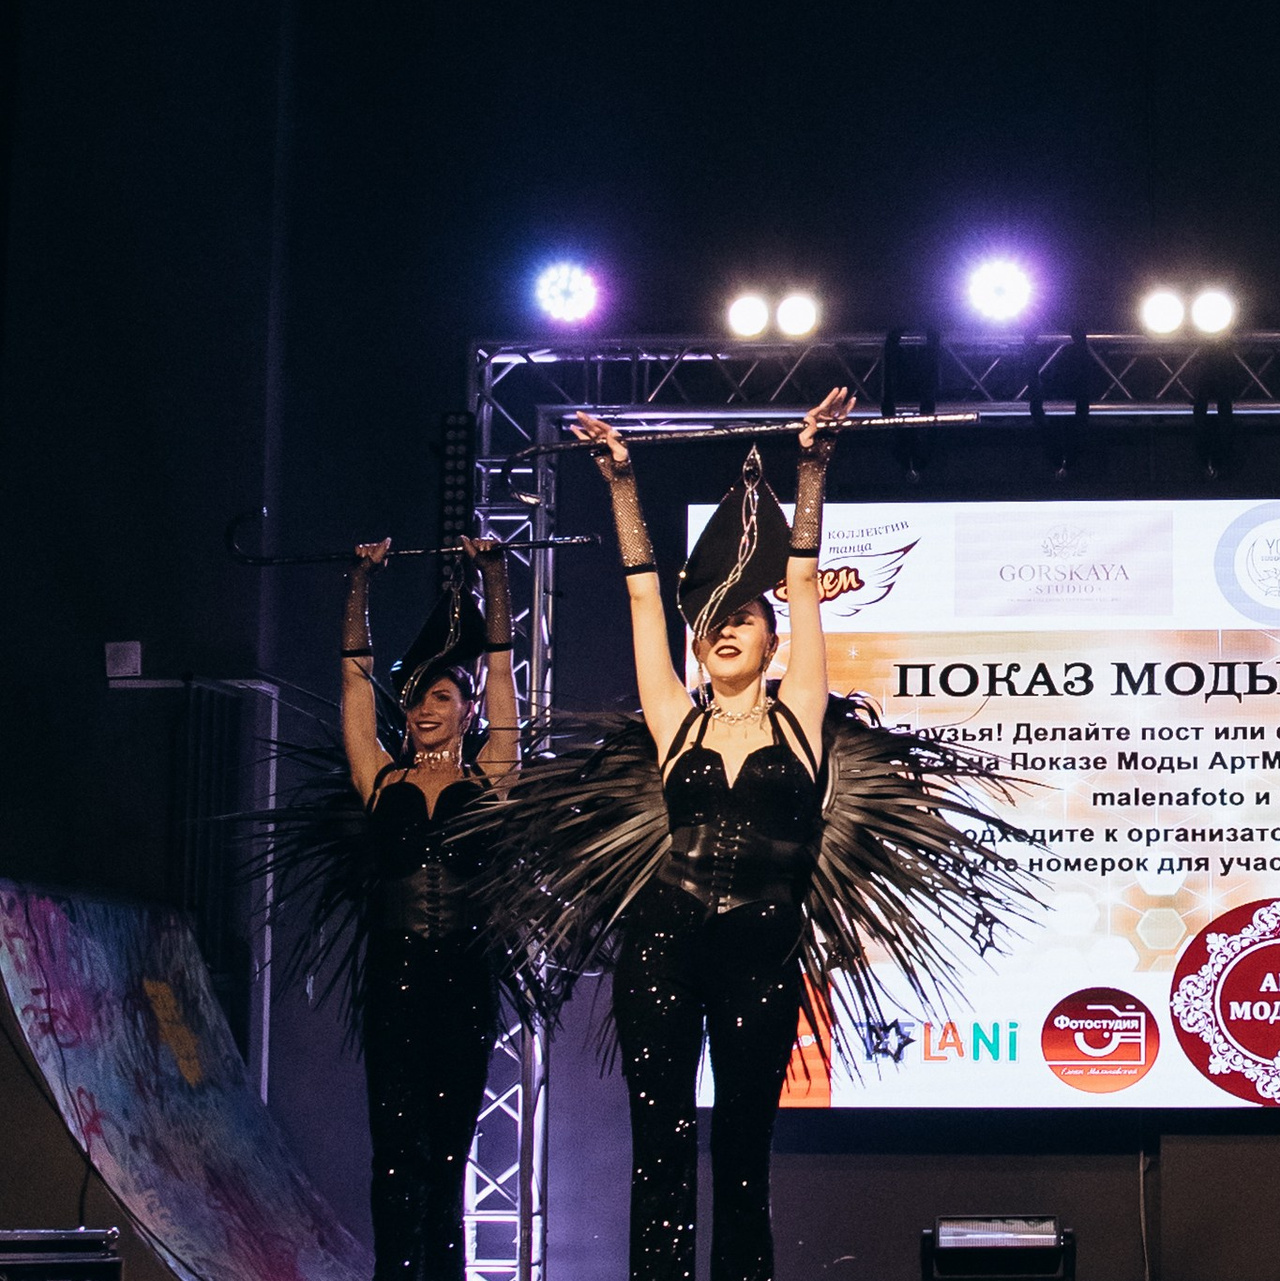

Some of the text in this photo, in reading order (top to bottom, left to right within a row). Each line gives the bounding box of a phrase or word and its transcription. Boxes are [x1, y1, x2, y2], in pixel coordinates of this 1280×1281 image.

[828, 520, 909, 540] КОЛЛЕКТИВ
[828, 542, 873, 555] танца
[999, 564, 1130, 582] GORSKAYA
[1035, 584, 1095, 595] STUDIO
[893, 662, 1094, 698] ПОКАЗ
[1013, 723, 1131, 745] Делайте
[1141, 727, 1204, 741] пост
[1215, 726, 1265, 740] или
[1011, 752, 1108, 770] Показе
[1118, 751, 1198, 773] Моды
[1092, 787, 1245, 807] malenafoto
[1255, 792, 1270, 806] и
[962, 827, 1095, 846] одходите
[1105, 828, 1118, 842] к
[1029, 857, 1149, 876] номерок
[1157, 856, 1210, 875] для
